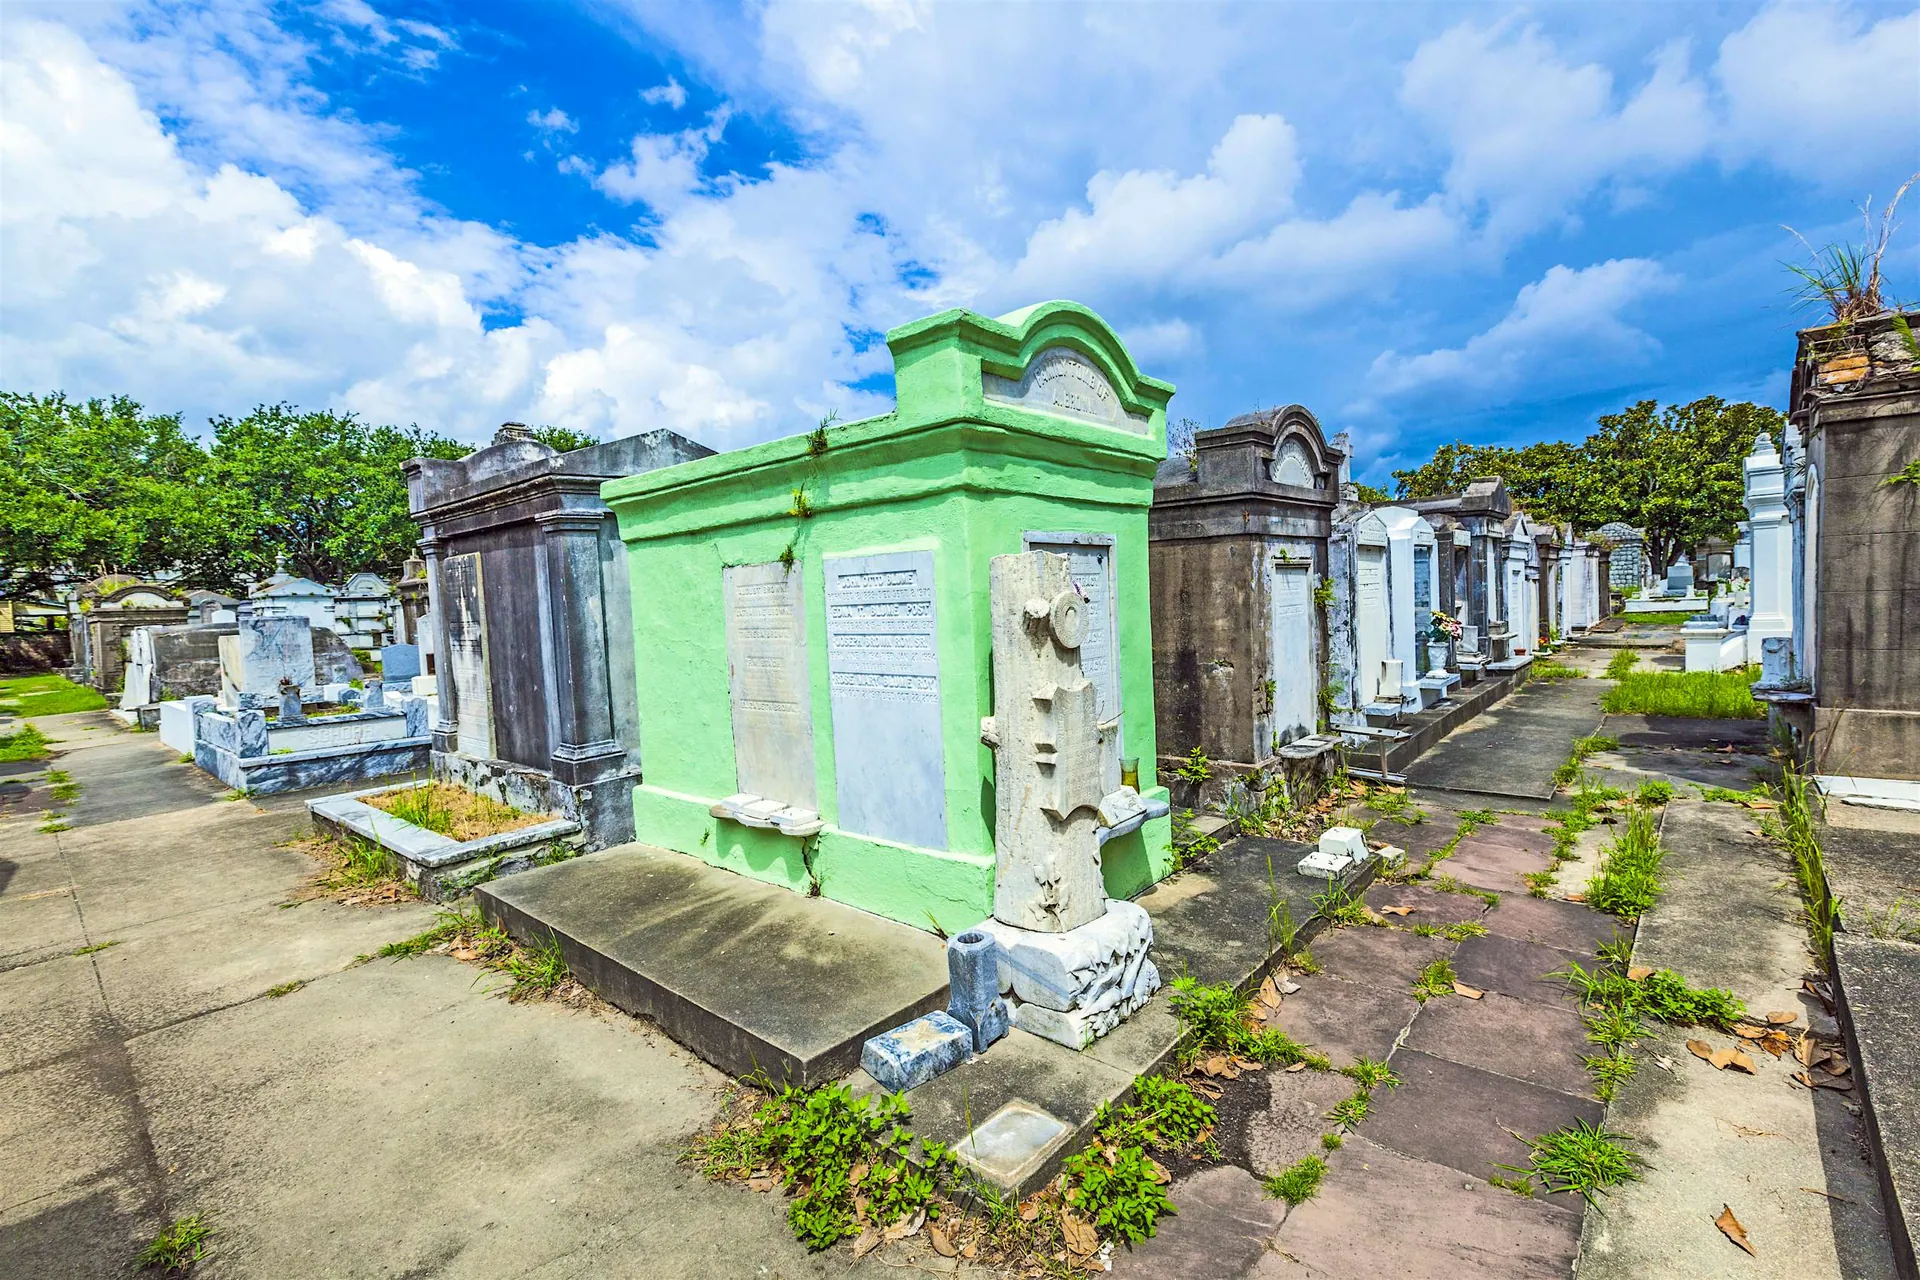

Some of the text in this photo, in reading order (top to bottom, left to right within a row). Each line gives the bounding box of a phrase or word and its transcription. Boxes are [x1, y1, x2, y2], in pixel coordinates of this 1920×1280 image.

[1096, 381, 1111, 402] OF
[905, 603, 931, 617] POST
[834, 674, 855, 686] ROSE
[858, 675, 880, 687] MARY
[917, 678, 936, 691] ROY
